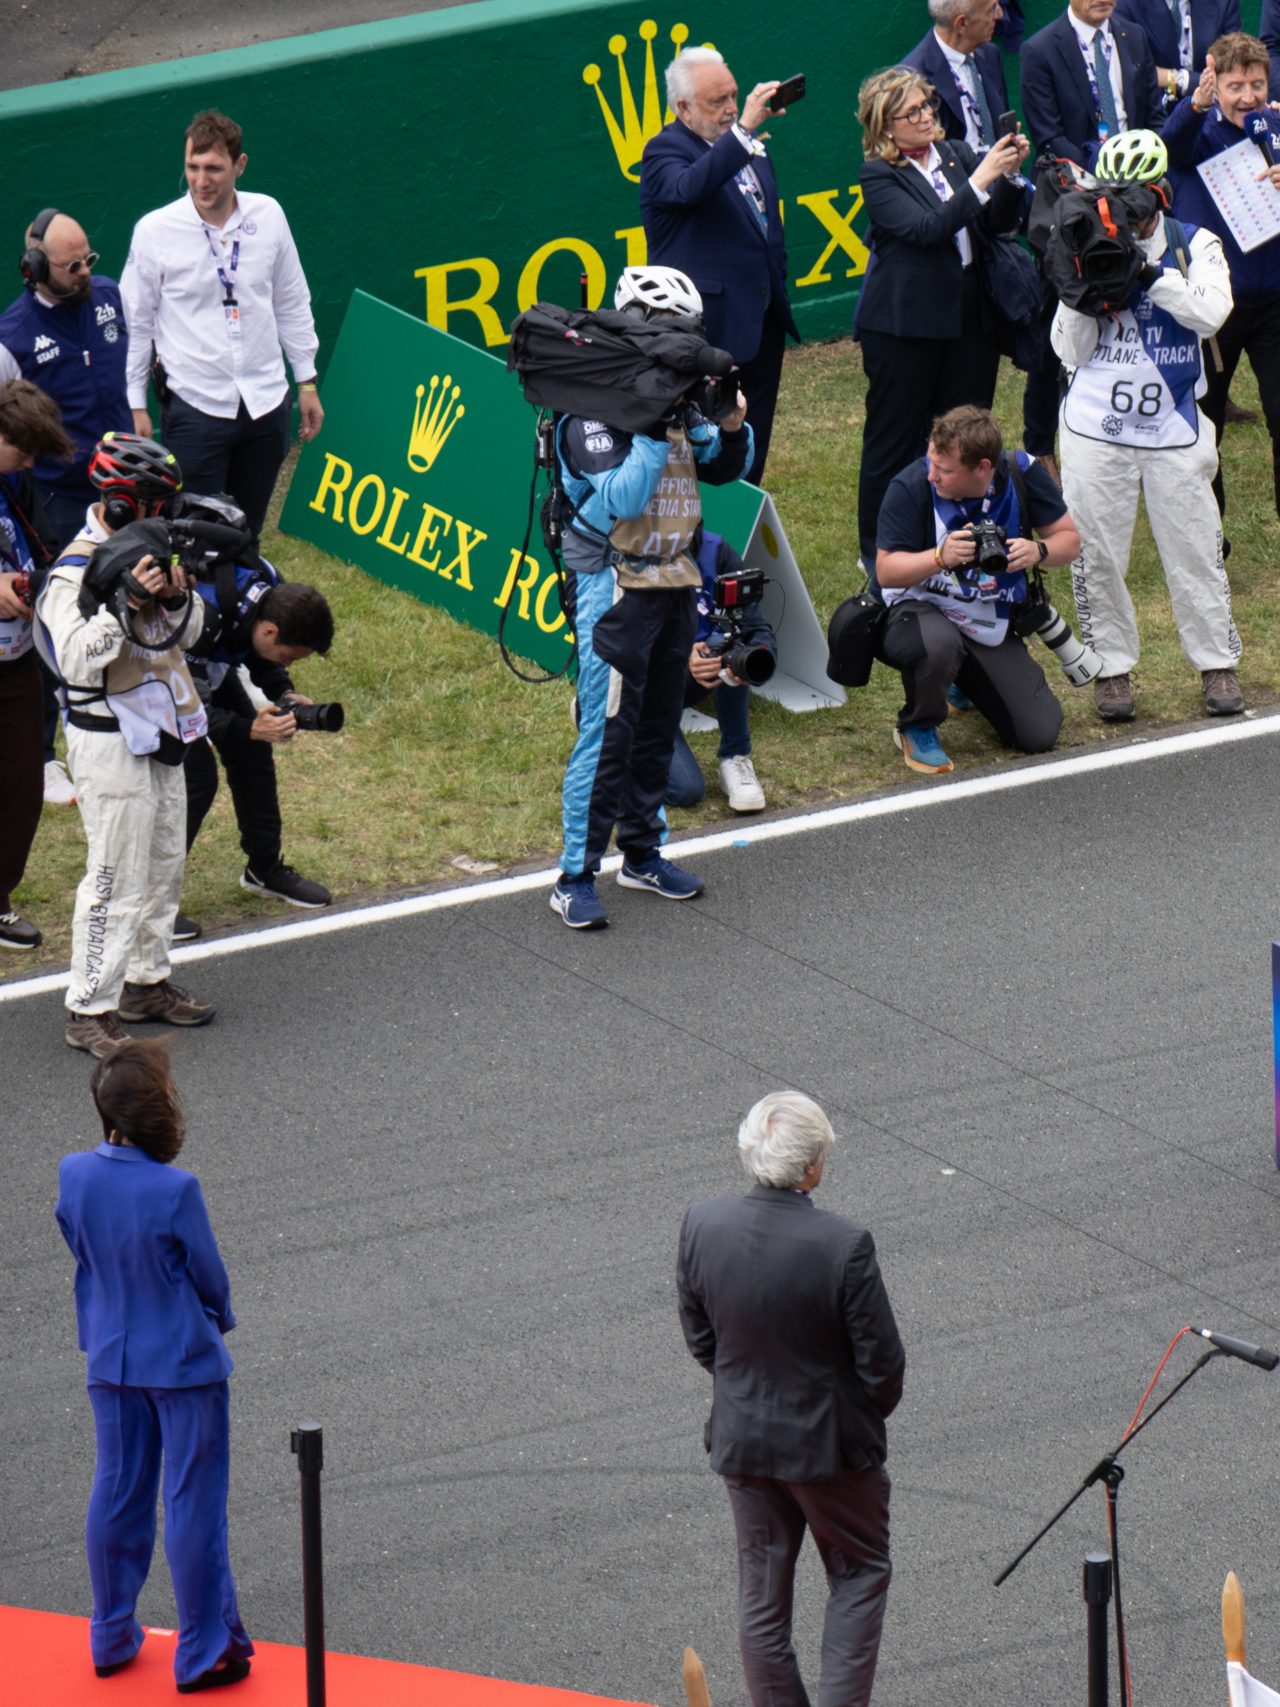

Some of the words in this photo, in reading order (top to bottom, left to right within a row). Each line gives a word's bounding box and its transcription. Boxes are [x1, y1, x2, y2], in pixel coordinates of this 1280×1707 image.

[1146, 326, 1163, 345] TV
[36, 346, 60, 364] STAFF
[1153, 345, 1196, 366] TRACK
[1110, 380, 1162, 417] 68
[588, 436, 611, 451] FIA
[309, 452, 488, 591] ROLEX
[1073, 575, 1095, 652] BROADCAS
[85, 633, 113, 662] ACO
[96, 864, 114, 903] HOST
